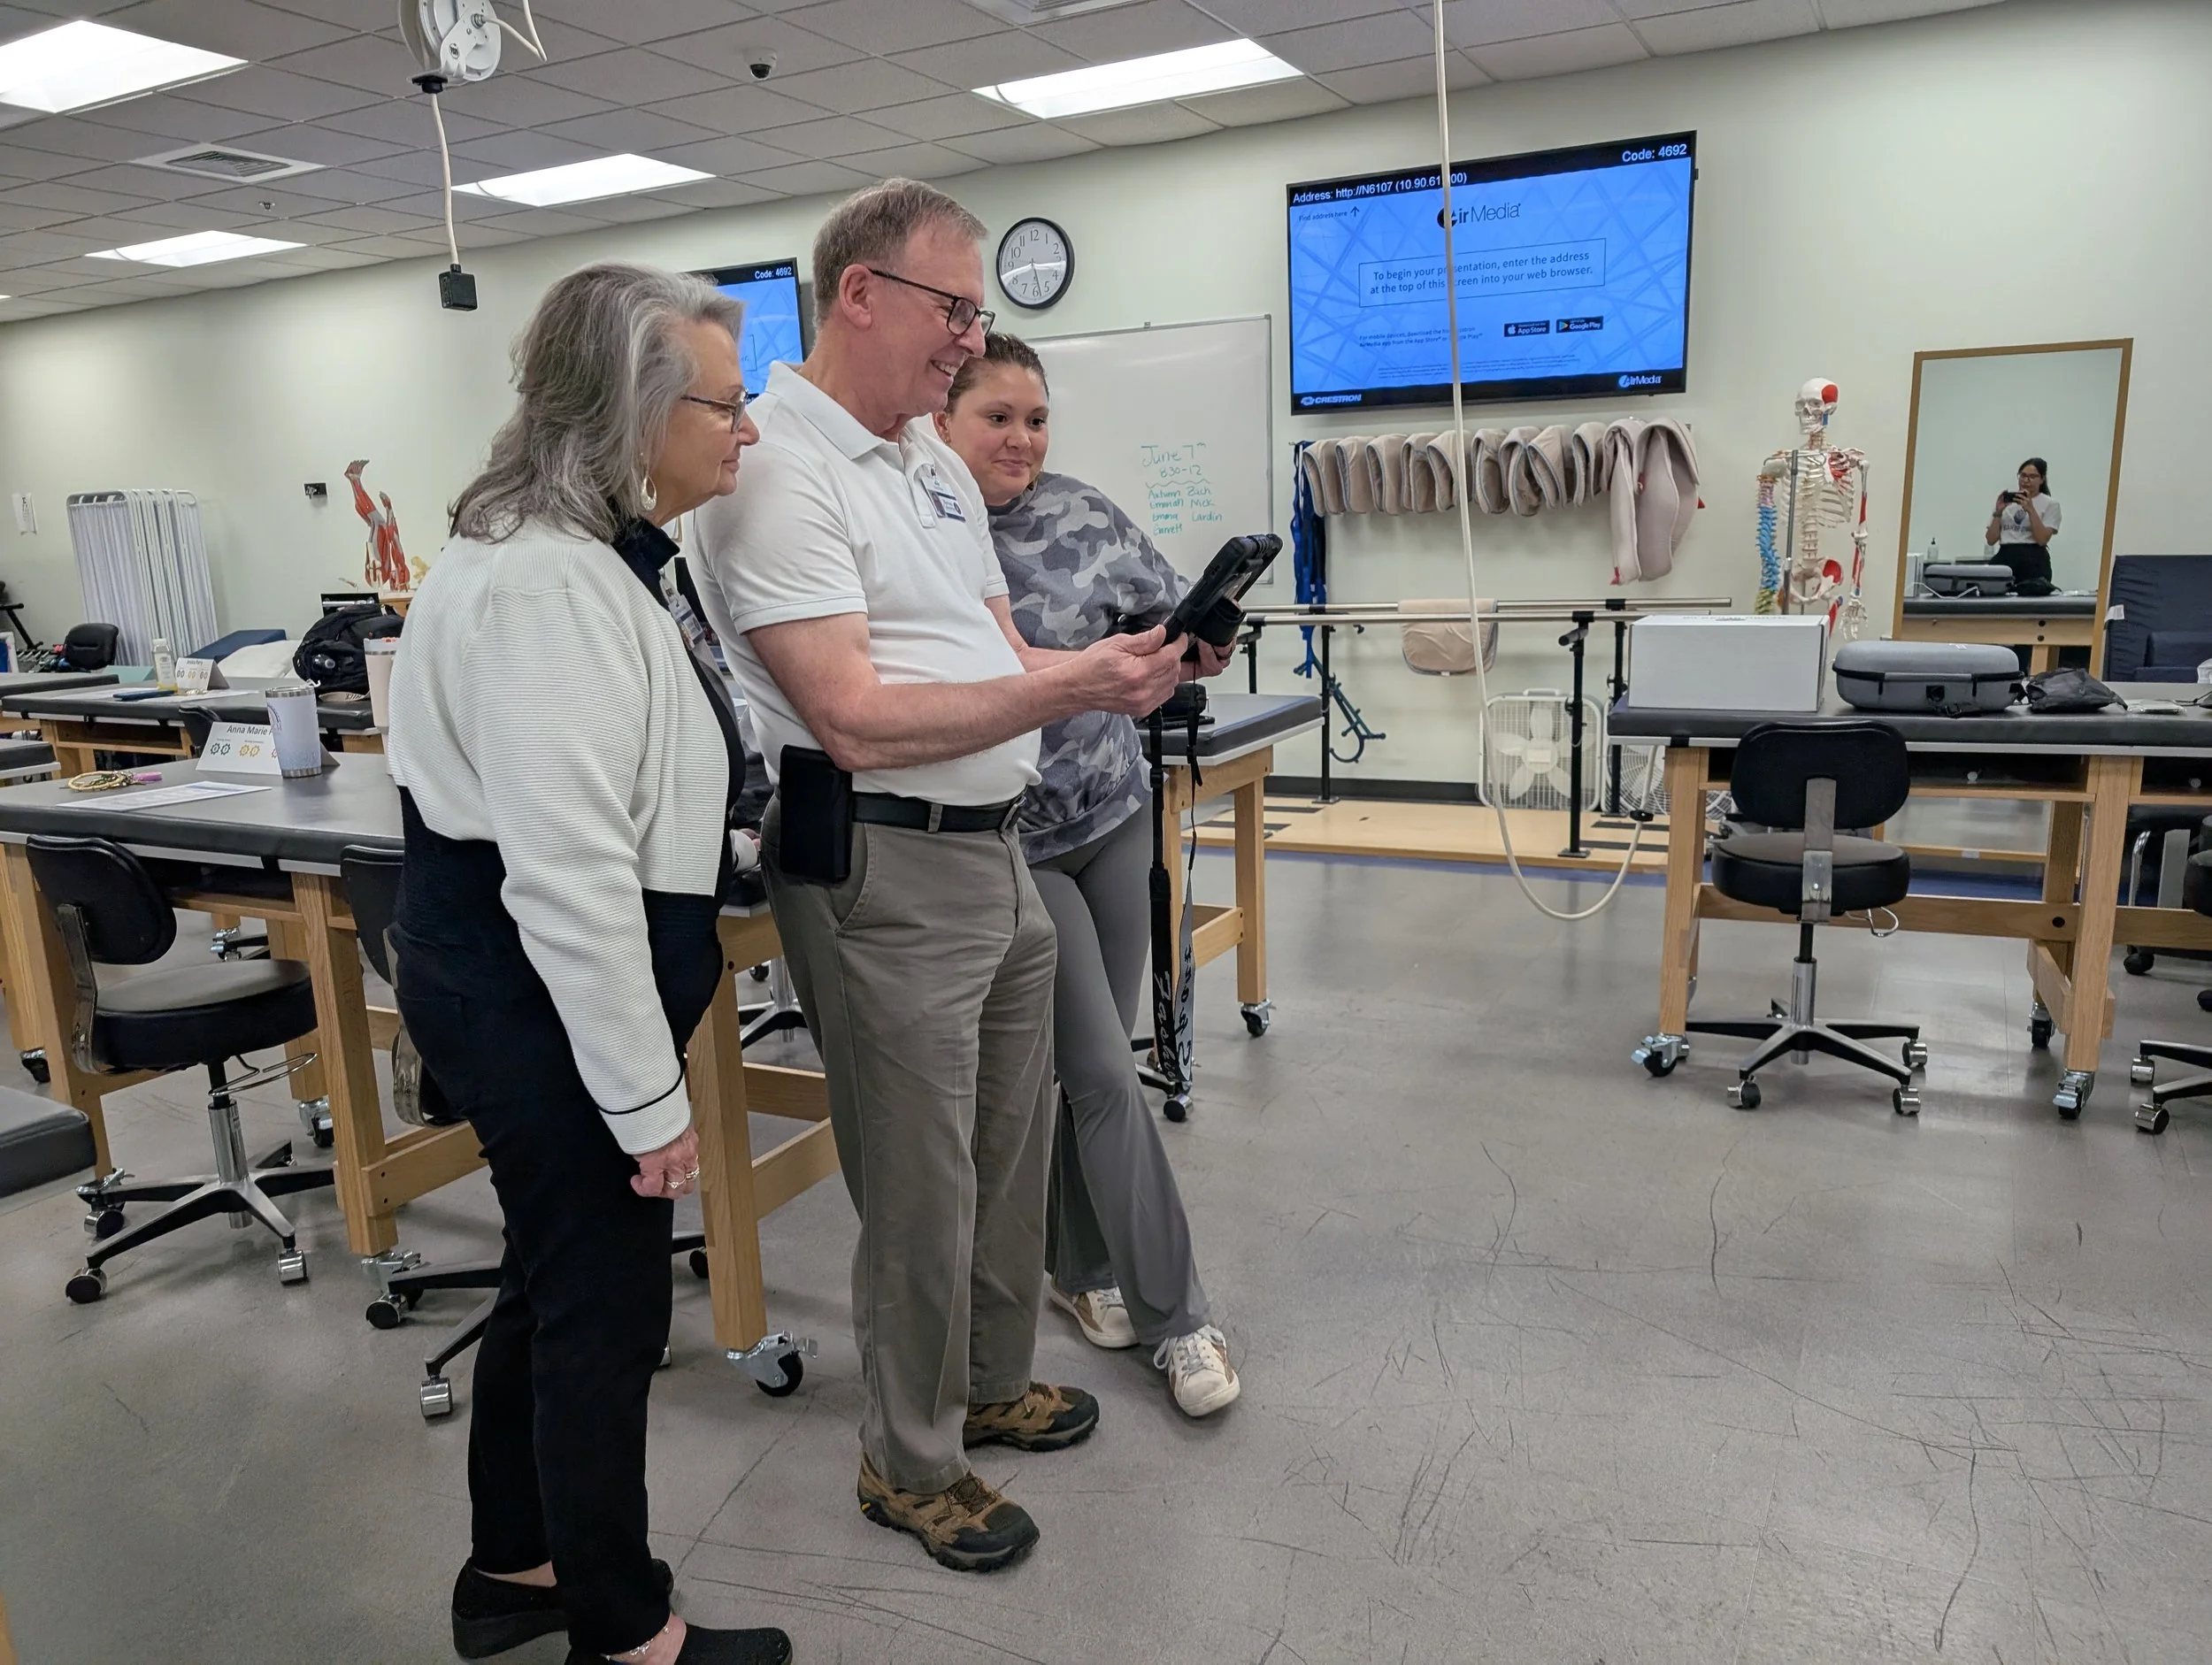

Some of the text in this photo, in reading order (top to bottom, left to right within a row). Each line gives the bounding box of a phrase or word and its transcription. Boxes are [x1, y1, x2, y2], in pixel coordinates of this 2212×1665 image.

[1622, 144, 1686, 162] Code: 4692
[1293, 190, 1333, 203] Address:
[1336, 181, 1392, 199] http://N6107
[1019, 235, 1025, 247] 11
[1030, 229, 1040, 242] 12
[1011, 247, 1021, 259] 10
[1053, 242, 1060, 255] 2
[1008, 261, 1014, 271] 9
[1373, 271, 1385, 280] To
[1386, 269, 1412, 281] begin
[1414, 267, 1434, 279] your
[1502, 257, 1528, 268] enter
[1532, 256, 1548, 265] the
[1549, 251, 1590, 264] address
[755, 266, 792, 280] Code: 4692
[1052, 270, 1059, 280] 4
[1012, 275, 1018, 285] 8
[1370, 286, 1379, 295] at
[1381, 283, 1397, 293] the
[1399, 282, 1414, 294] top
[1416, 280, 1426, 290] of
[1428, 278, 1446, 288] this
[1481, 273, 1500, 284] into
[1502, 272, 1525, 284] your
[1527, 269, 1548, 280] web
[1549, 265, 1593, 278] browser.
[1021, 283, 1028, 295] 7
[1033, 286, 1039, 297] 6
[1044, 280, 1050, 293] 5
[1315, 393, 1363, 404] CRESTRON
[1141, 444, 1181, 467] June
[1187, 485, 1211, 496] Zach
[1190, 498, 1216, 508] Nick
[227, 725, 245, 734] Anna
[246, 725, 268, 735] Marie
